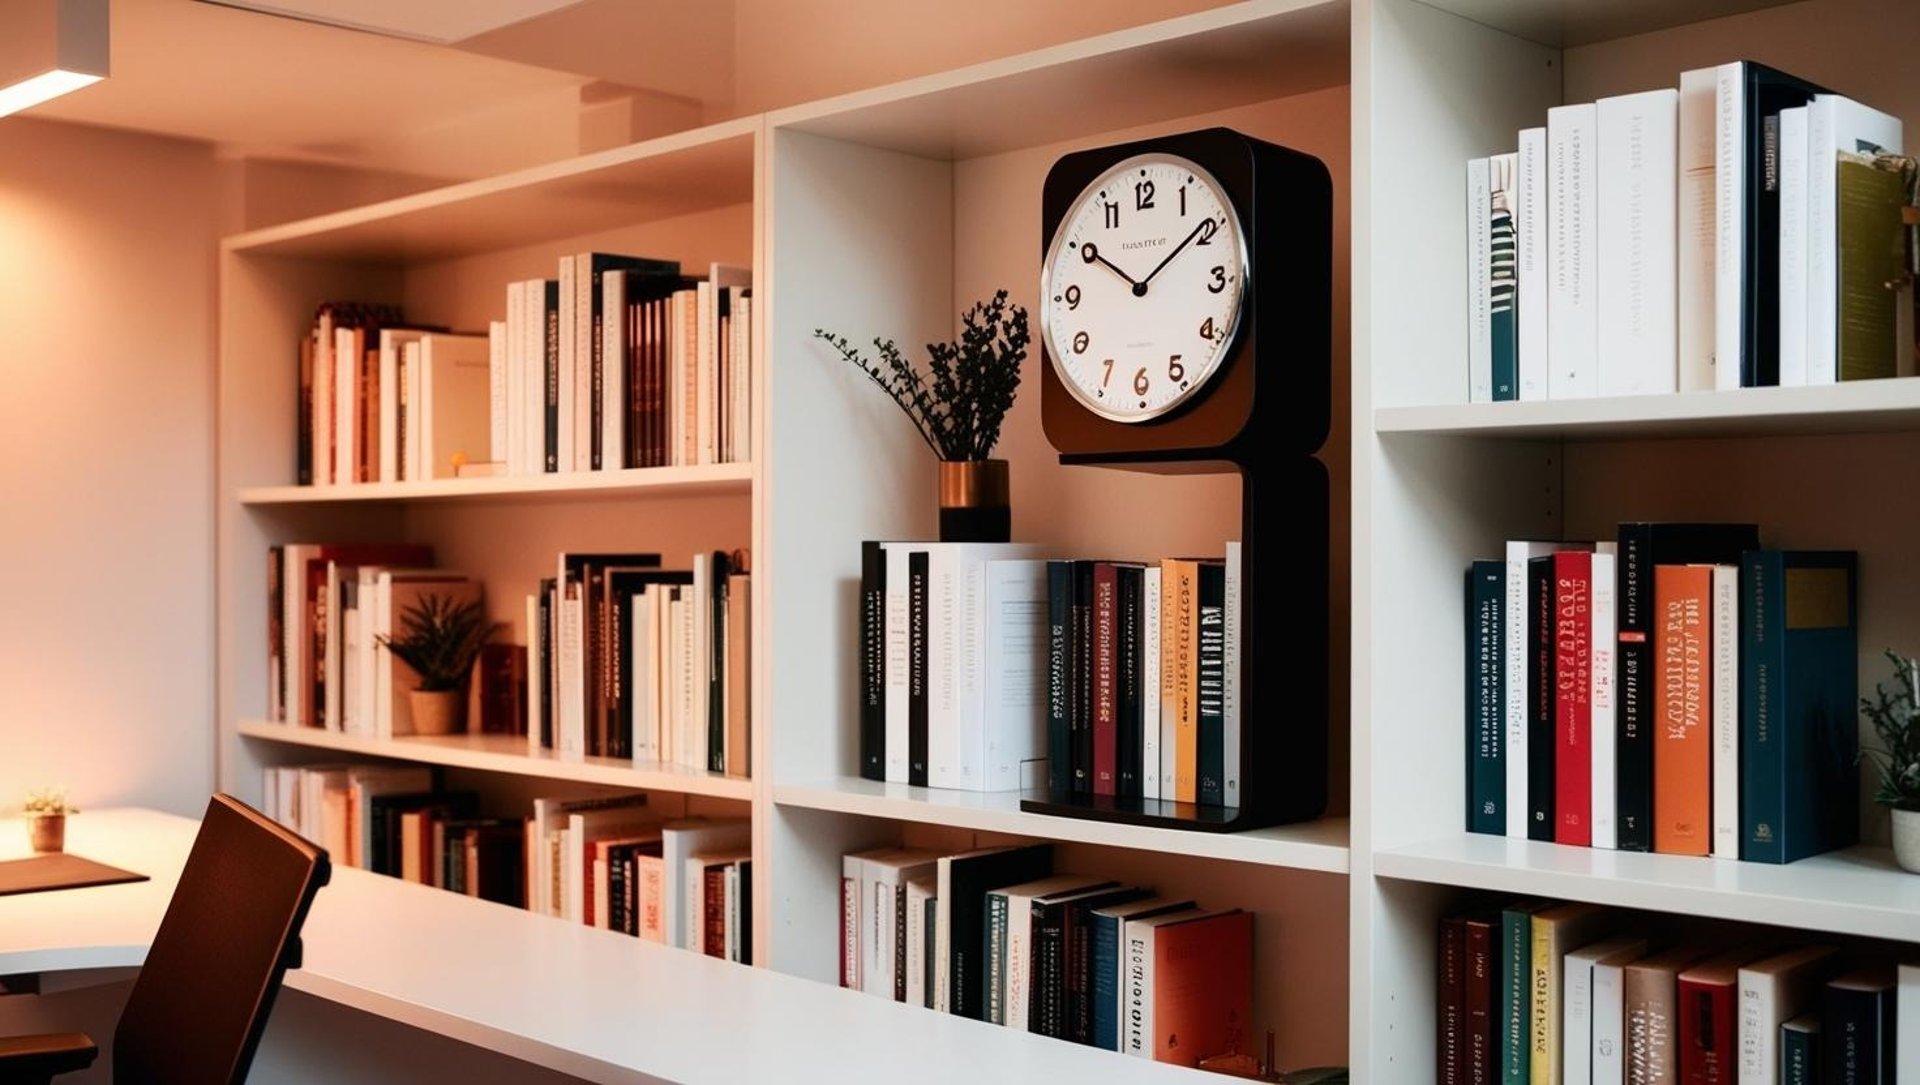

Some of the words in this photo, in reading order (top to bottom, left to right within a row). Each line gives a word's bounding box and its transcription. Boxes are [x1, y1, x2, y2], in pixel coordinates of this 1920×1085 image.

[1135, 180, 1154, 211] 12
[1179, 186, 1186, 216] 1
[1207, 266, 1225, 294] 3
[1065, 285, 1080, 310] 9
[1073, 331, 1089, 354] 8
[1103, 360, 1114, 387] 7
[1134, 367, 1149, 395] 6
[1169, 355, 1184, 382] 5
